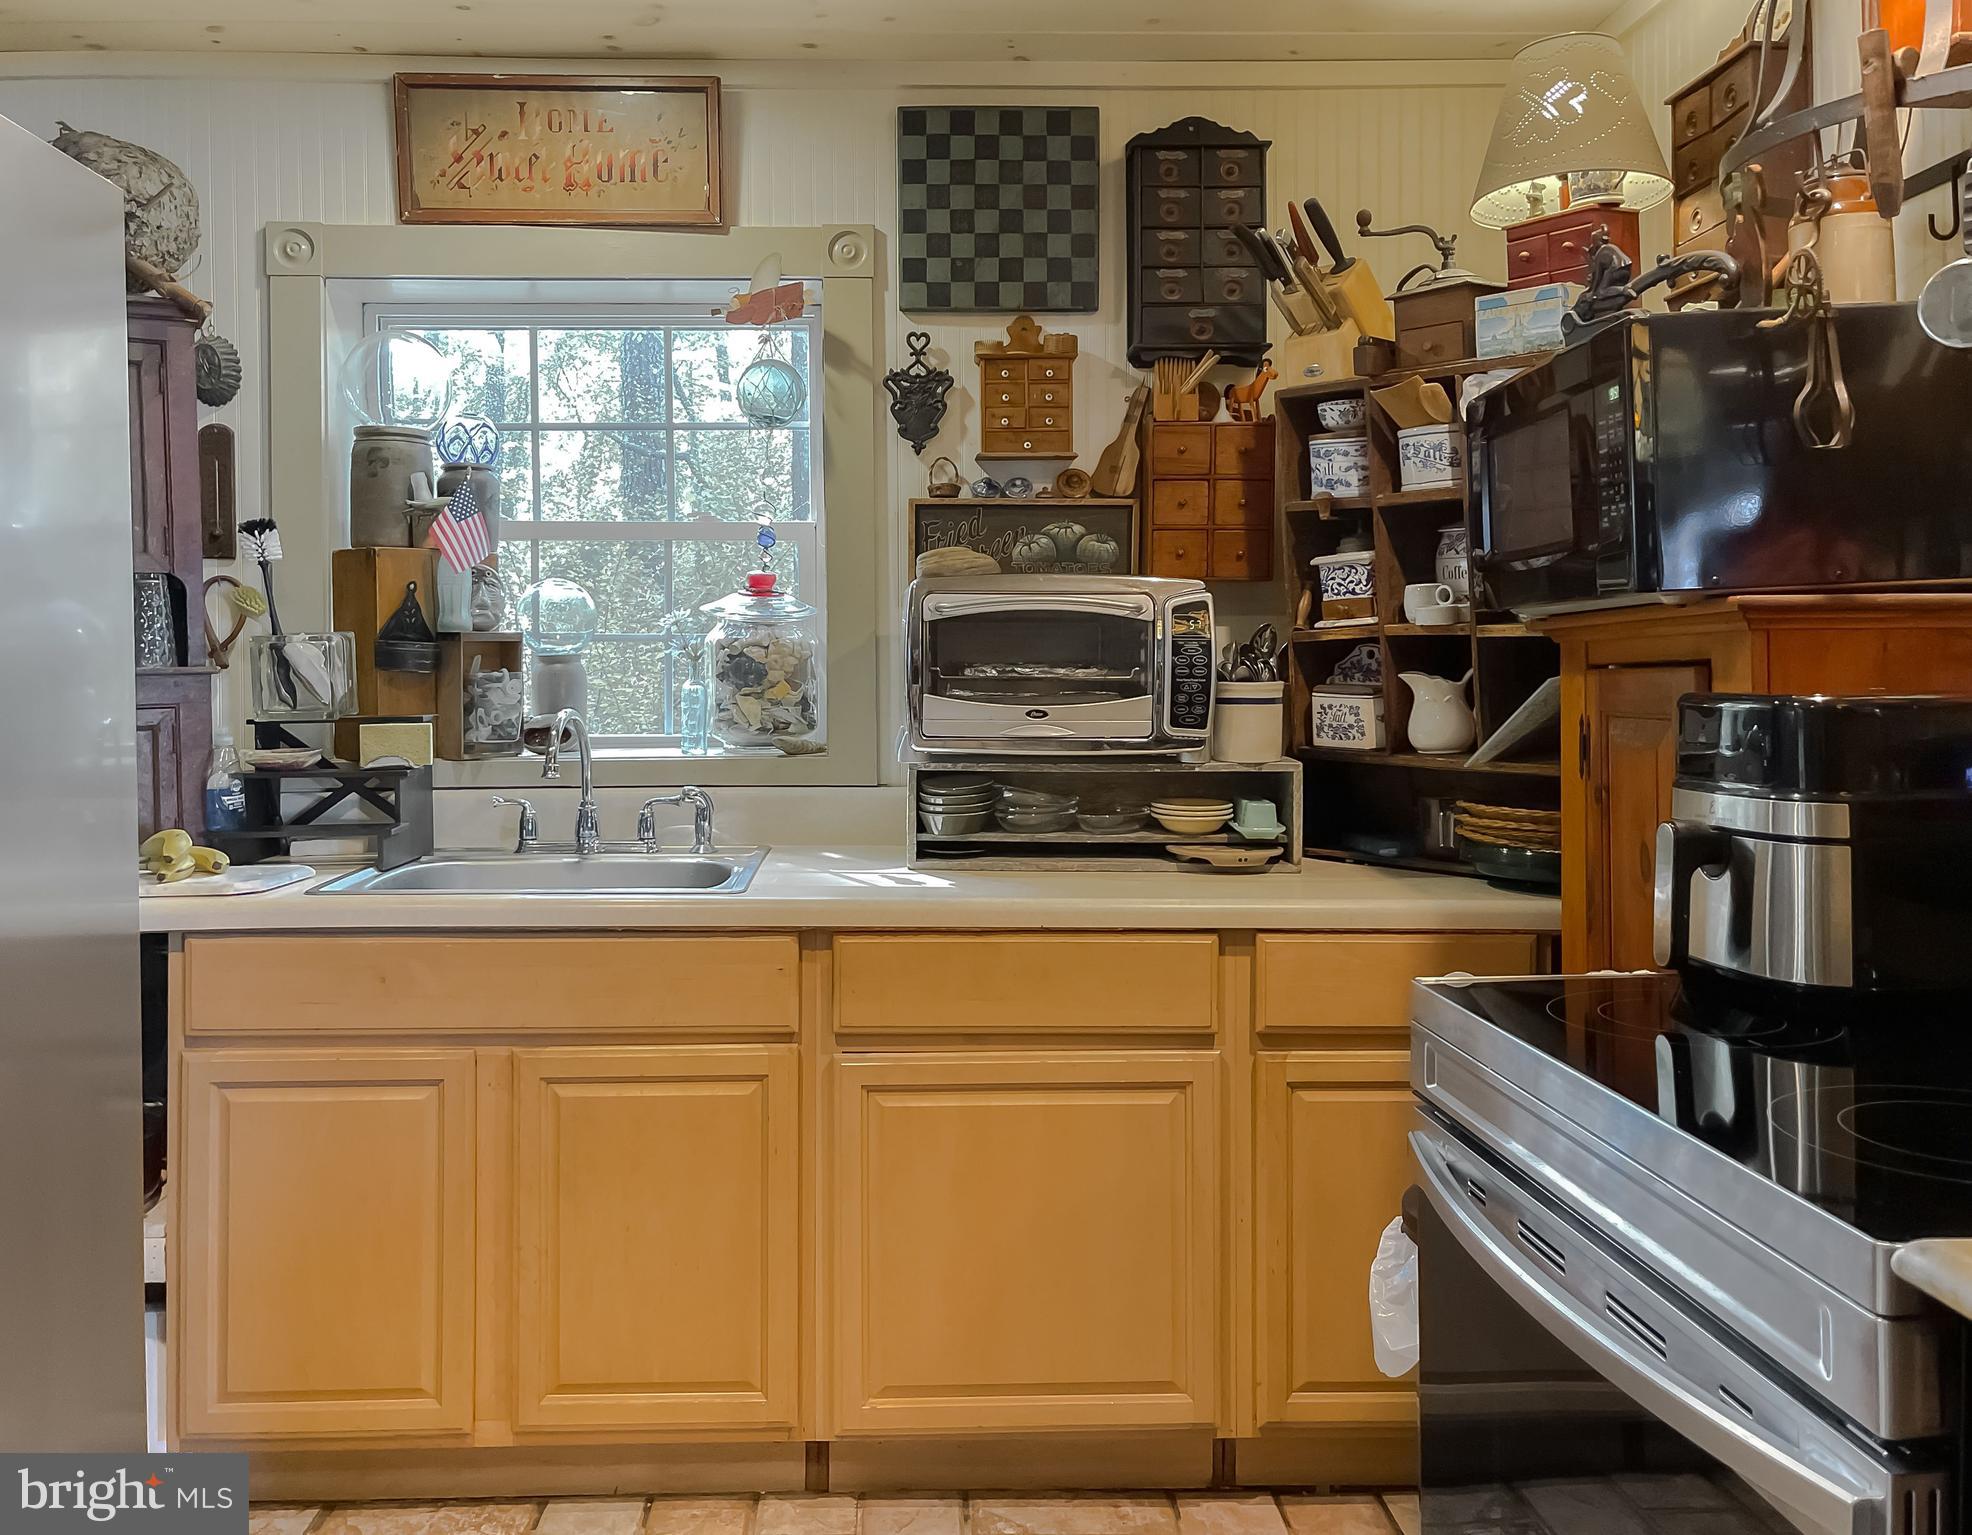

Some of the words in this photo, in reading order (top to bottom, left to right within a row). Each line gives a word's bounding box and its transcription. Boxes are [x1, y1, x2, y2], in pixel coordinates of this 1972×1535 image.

[921, 506, 987, 552] Fried
[965, 525, 1027, 562] reen
[1010, 561, 1112, 574] TOMATOES
[1442, 564, 1468, 580] Coffe
